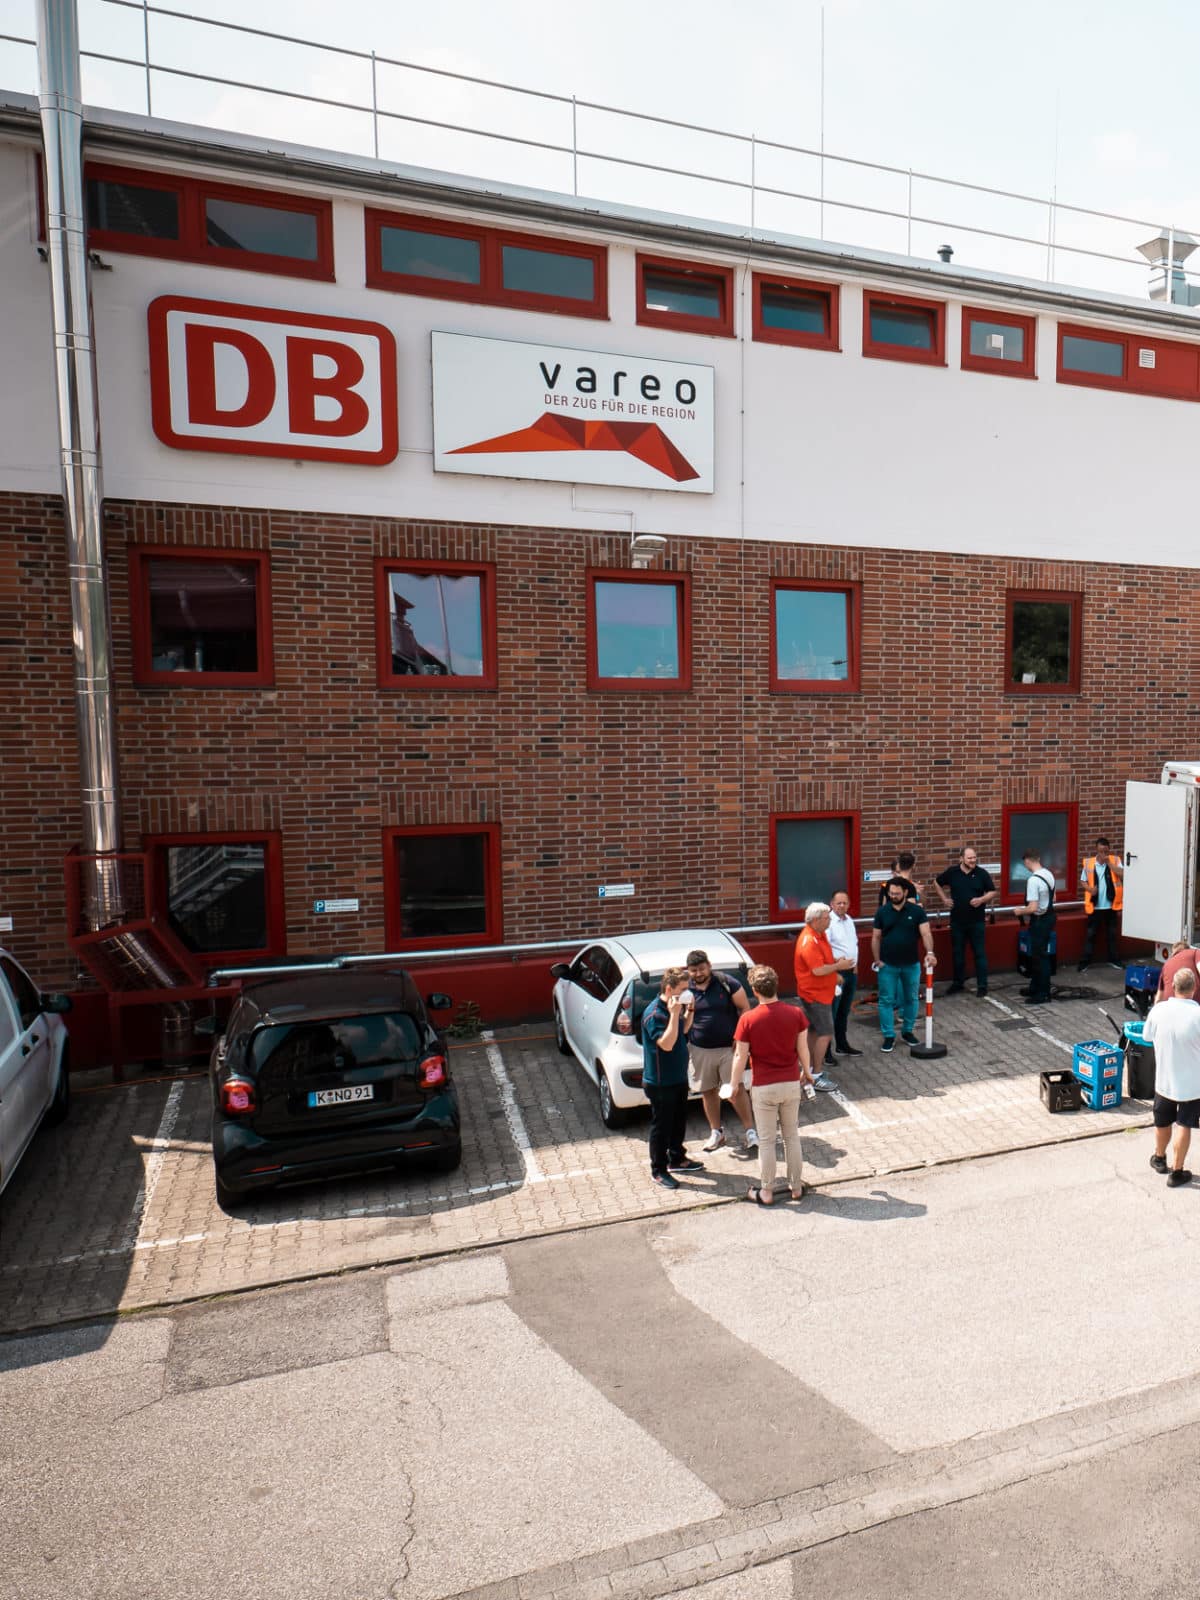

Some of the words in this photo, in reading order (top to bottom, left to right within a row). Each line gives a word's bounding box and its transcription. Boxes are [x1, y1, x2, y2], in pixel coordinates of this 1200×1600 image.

[185, 323, 370, 438] DB
[539, 362, 697, 405] vareo
[544, 394, 569, 407] DER
[572, 397, 597, 410] ZUG
[602, 398, 624, 413] FÜR
[628, 403, 648, 415] DIE
[652, 405, 696, 420] REGION
[317, 1092, 326, 1104] K
[355, 1086, 371, 1098] 91
